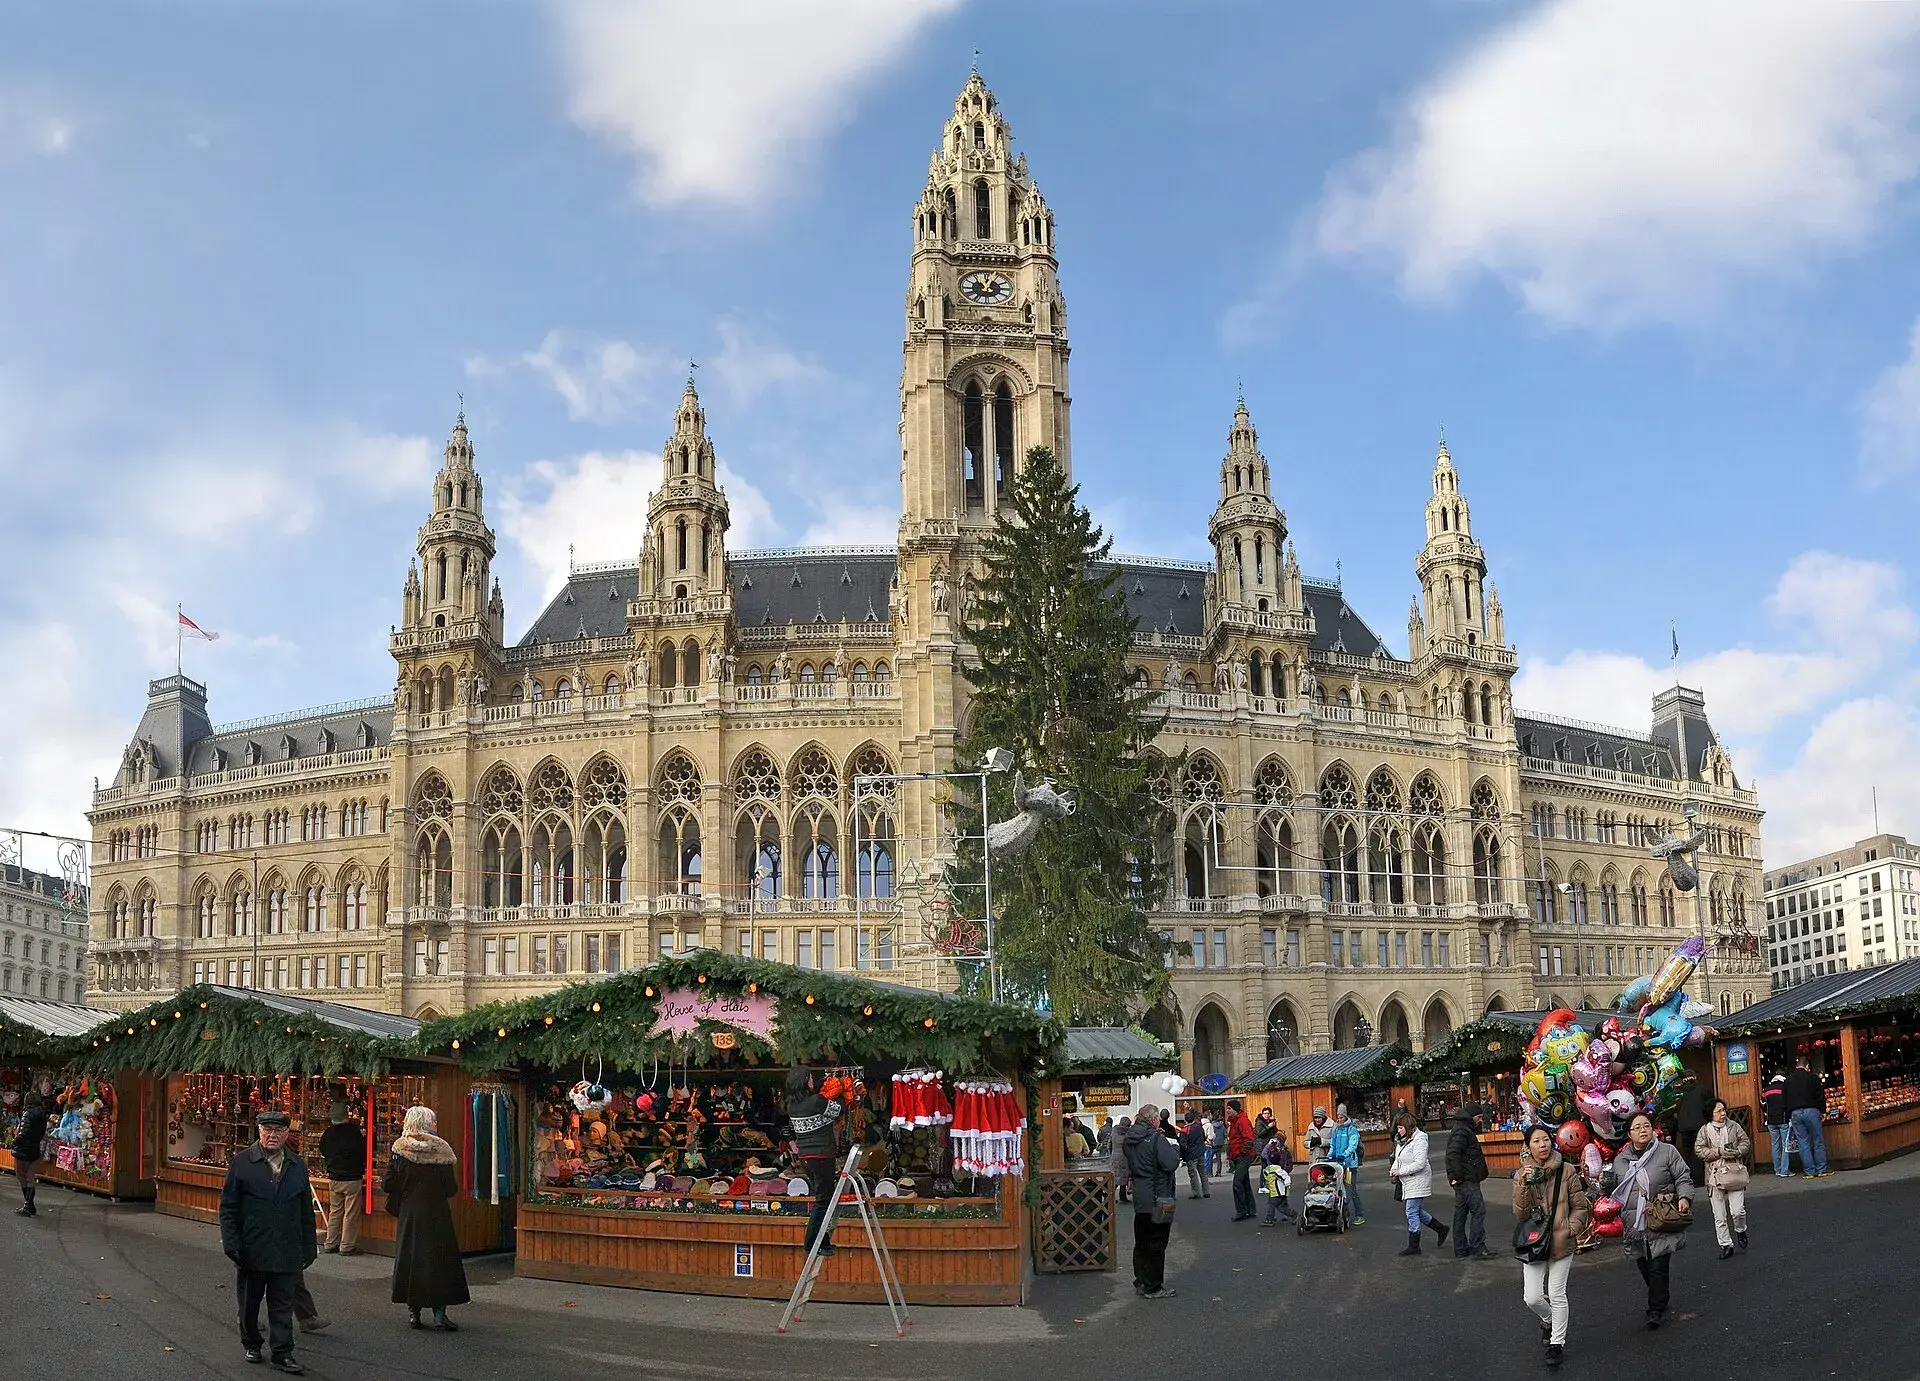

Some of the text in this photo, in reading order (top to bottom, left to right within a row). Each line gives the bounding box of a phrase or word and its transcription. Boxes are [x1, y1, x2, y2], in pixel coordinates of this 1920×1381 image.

[664, 999, 749, 1021] House of Hats
[716, 1034, 733, 1045] 138
[1112, 1087, 1125, 1095] UND
